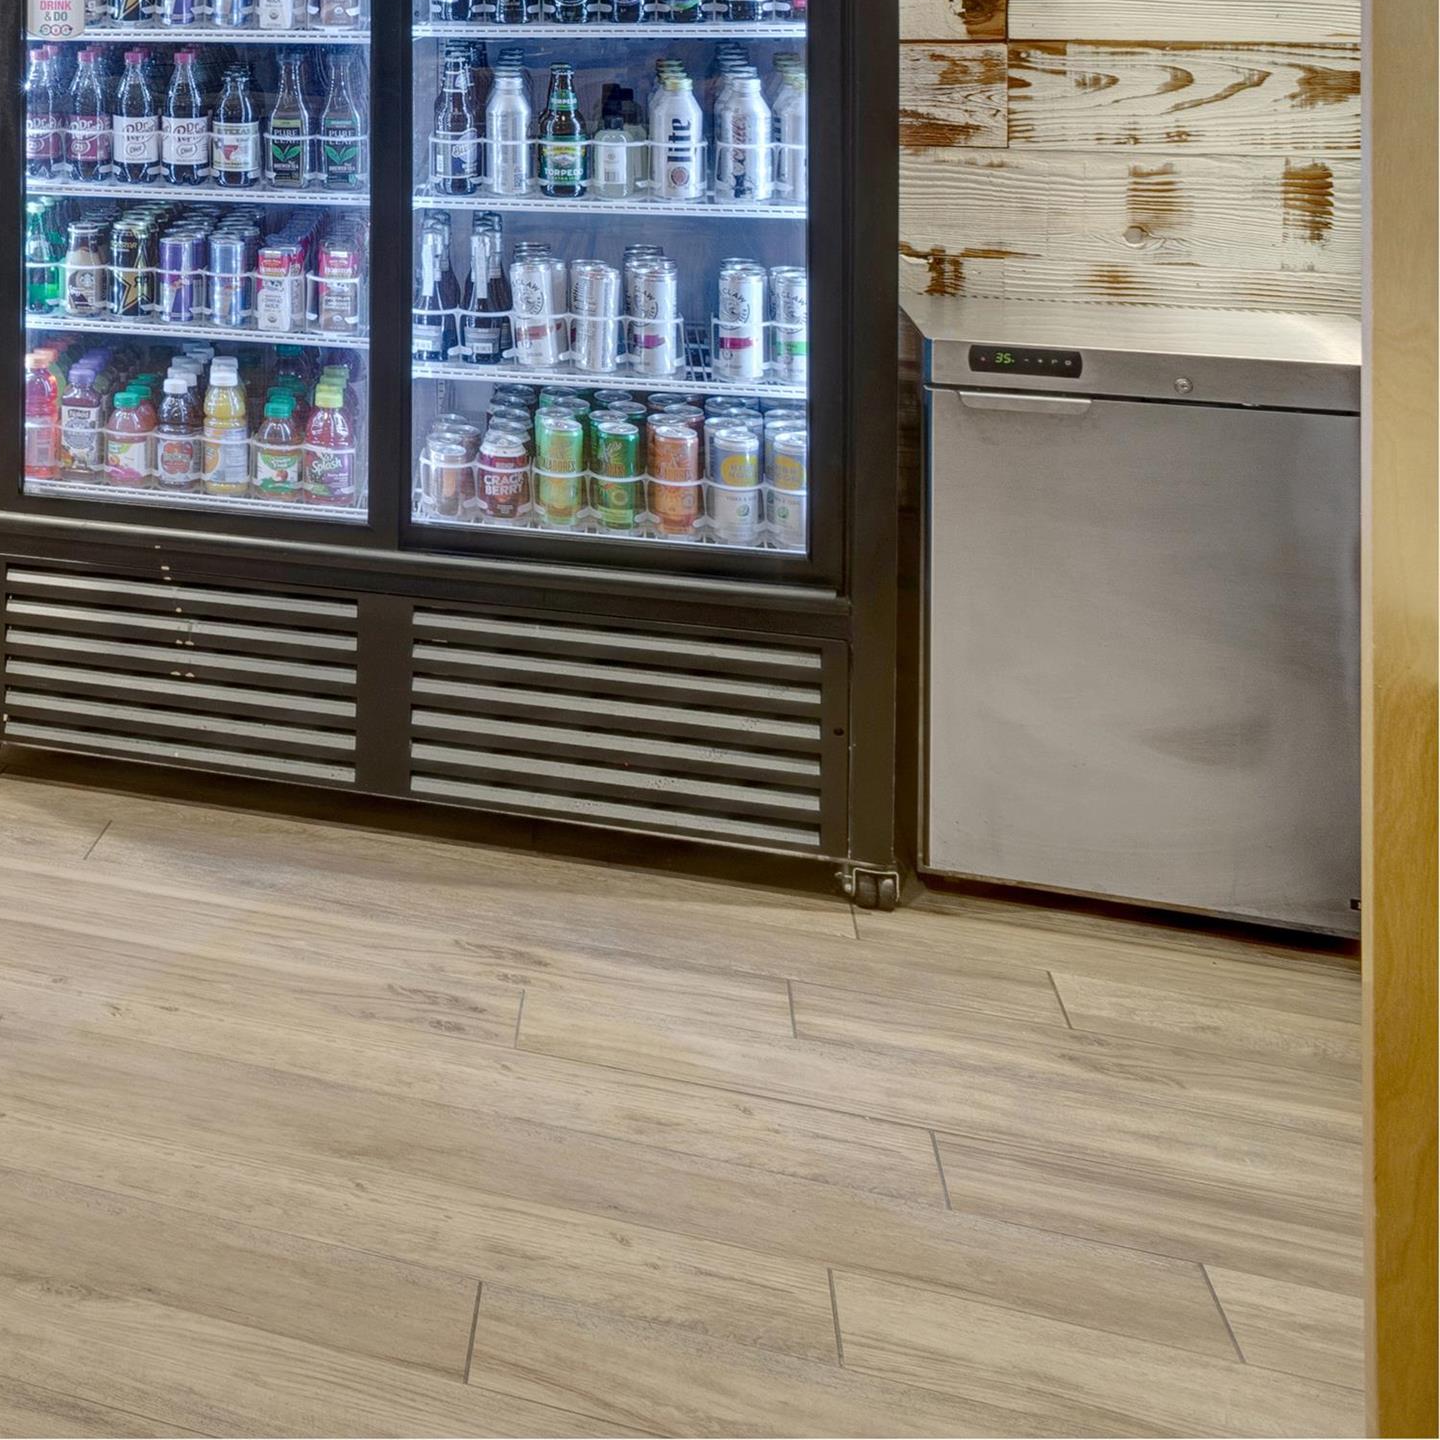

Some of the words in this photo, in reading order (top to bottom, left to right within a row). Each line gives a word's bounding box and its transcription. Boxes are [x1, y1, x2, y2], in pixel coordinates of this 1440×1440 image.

[40, 0, 71, 10] DRINK
[53, 12, 68, 21] DO
[667, 118, 691, 162] lite
[544, 167, 584, 176] TORPEDO
